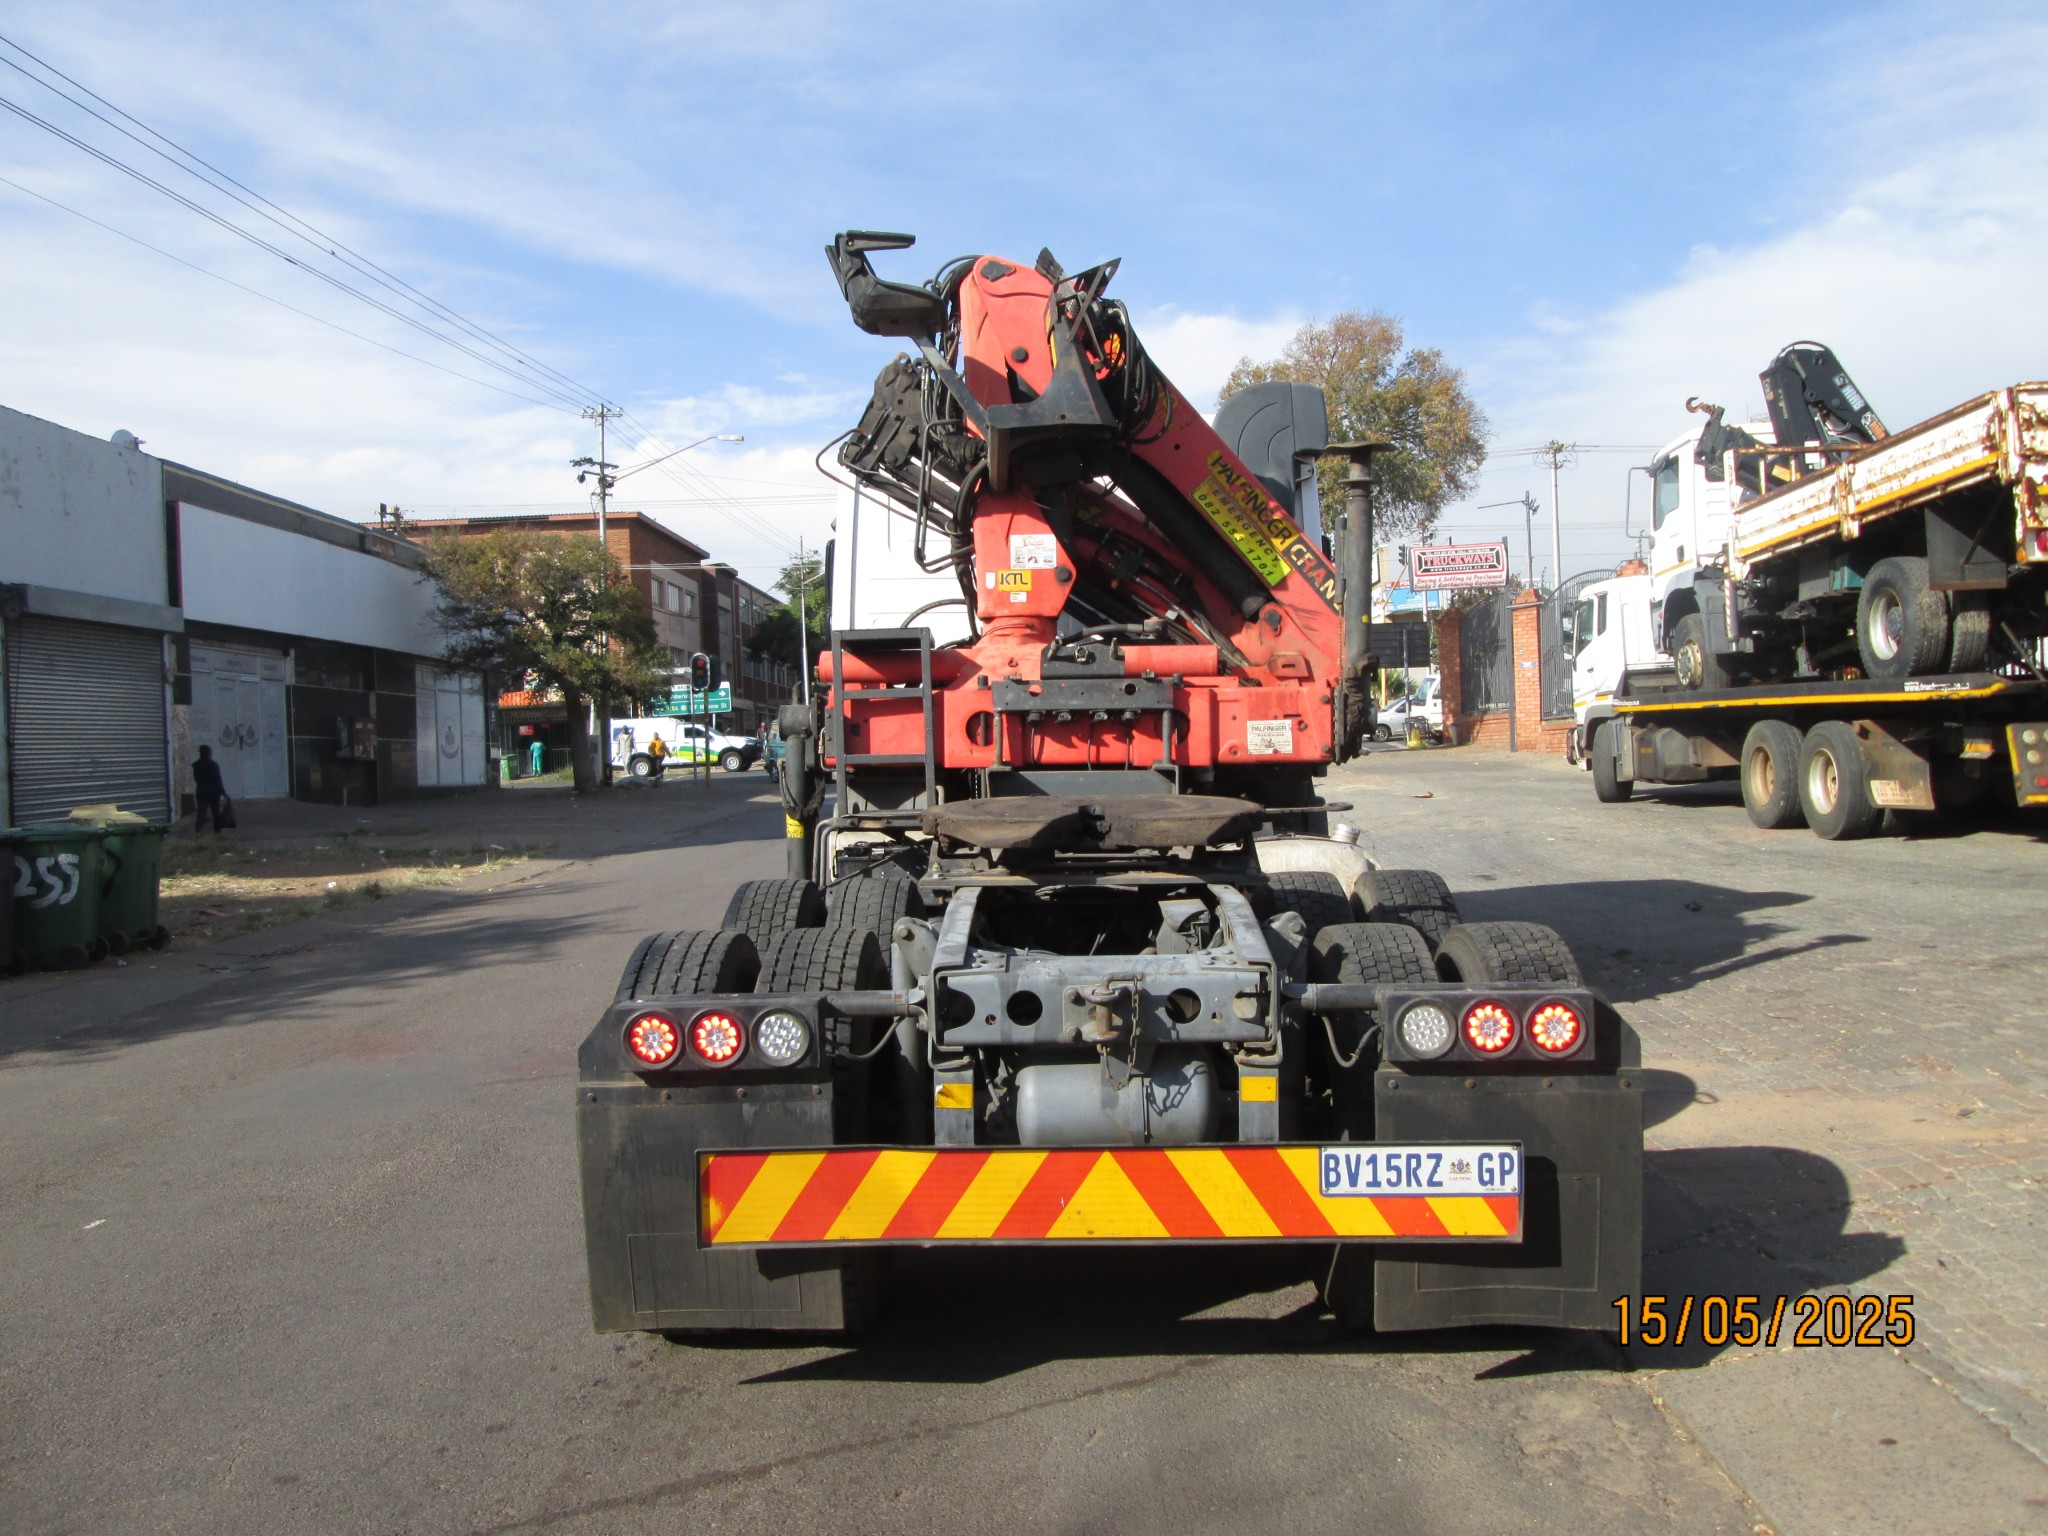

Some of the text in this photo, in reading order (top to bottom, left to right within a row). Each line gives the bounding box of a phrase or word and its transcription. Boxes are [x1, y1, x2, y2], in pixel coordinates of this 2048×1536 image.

[1198, 494, 1221, 517] 082
[1424, 553, 1494, 567] TRUCKWAYS
[1323, 1152, 1515, 1188] BV15RZ GP
